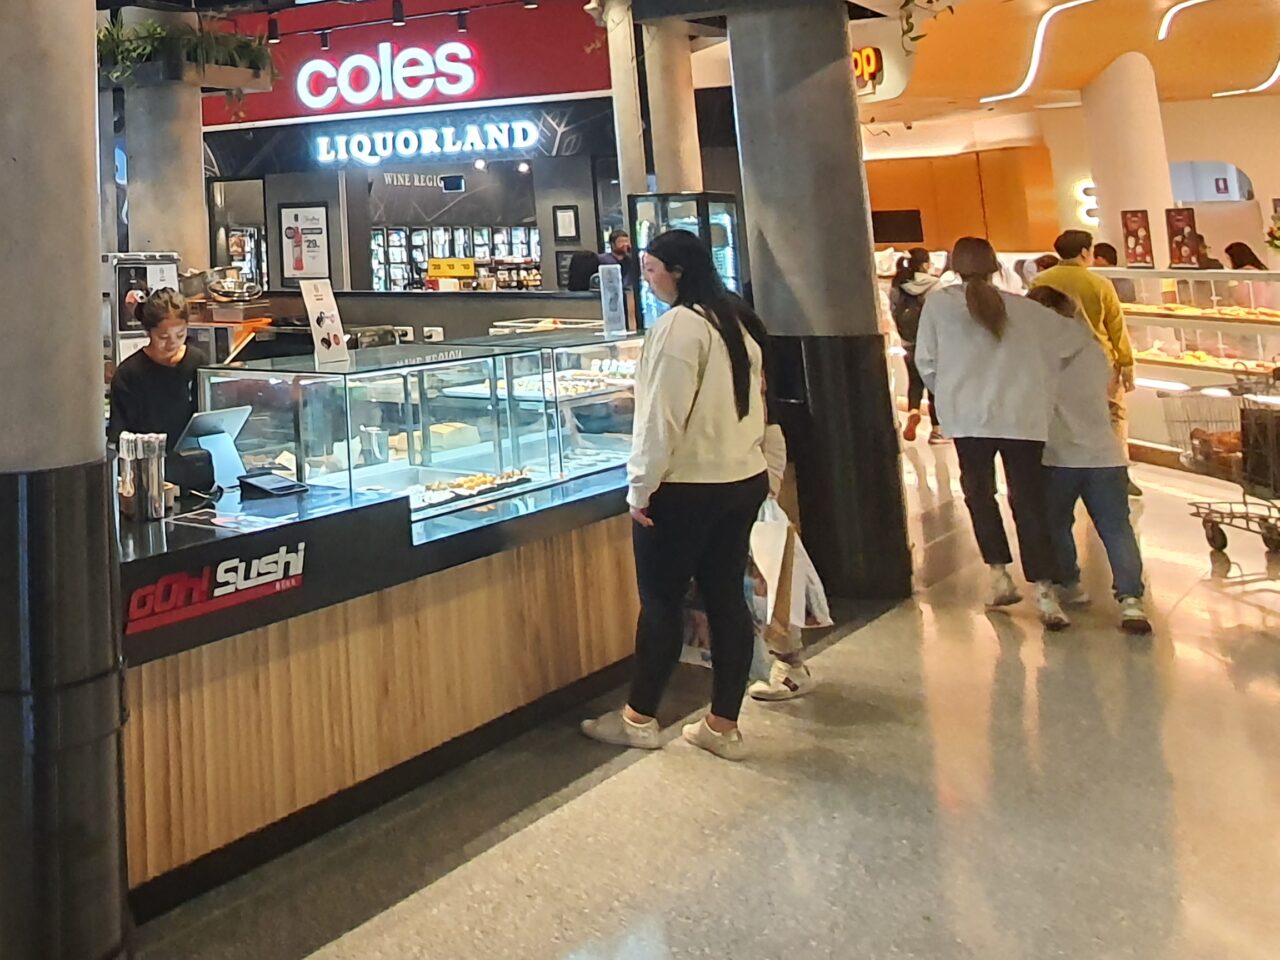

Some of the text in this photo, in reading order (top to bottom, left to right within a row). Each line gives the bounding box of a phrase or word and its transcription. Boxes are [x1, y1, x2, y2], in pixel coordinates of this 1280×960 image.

[296, 41, 474, 109] coles
[317, 120, 539, 166] LIQUORLAND
[383, 172, 411, 186] WINE
[213, 541, 306, 597] Sushi
